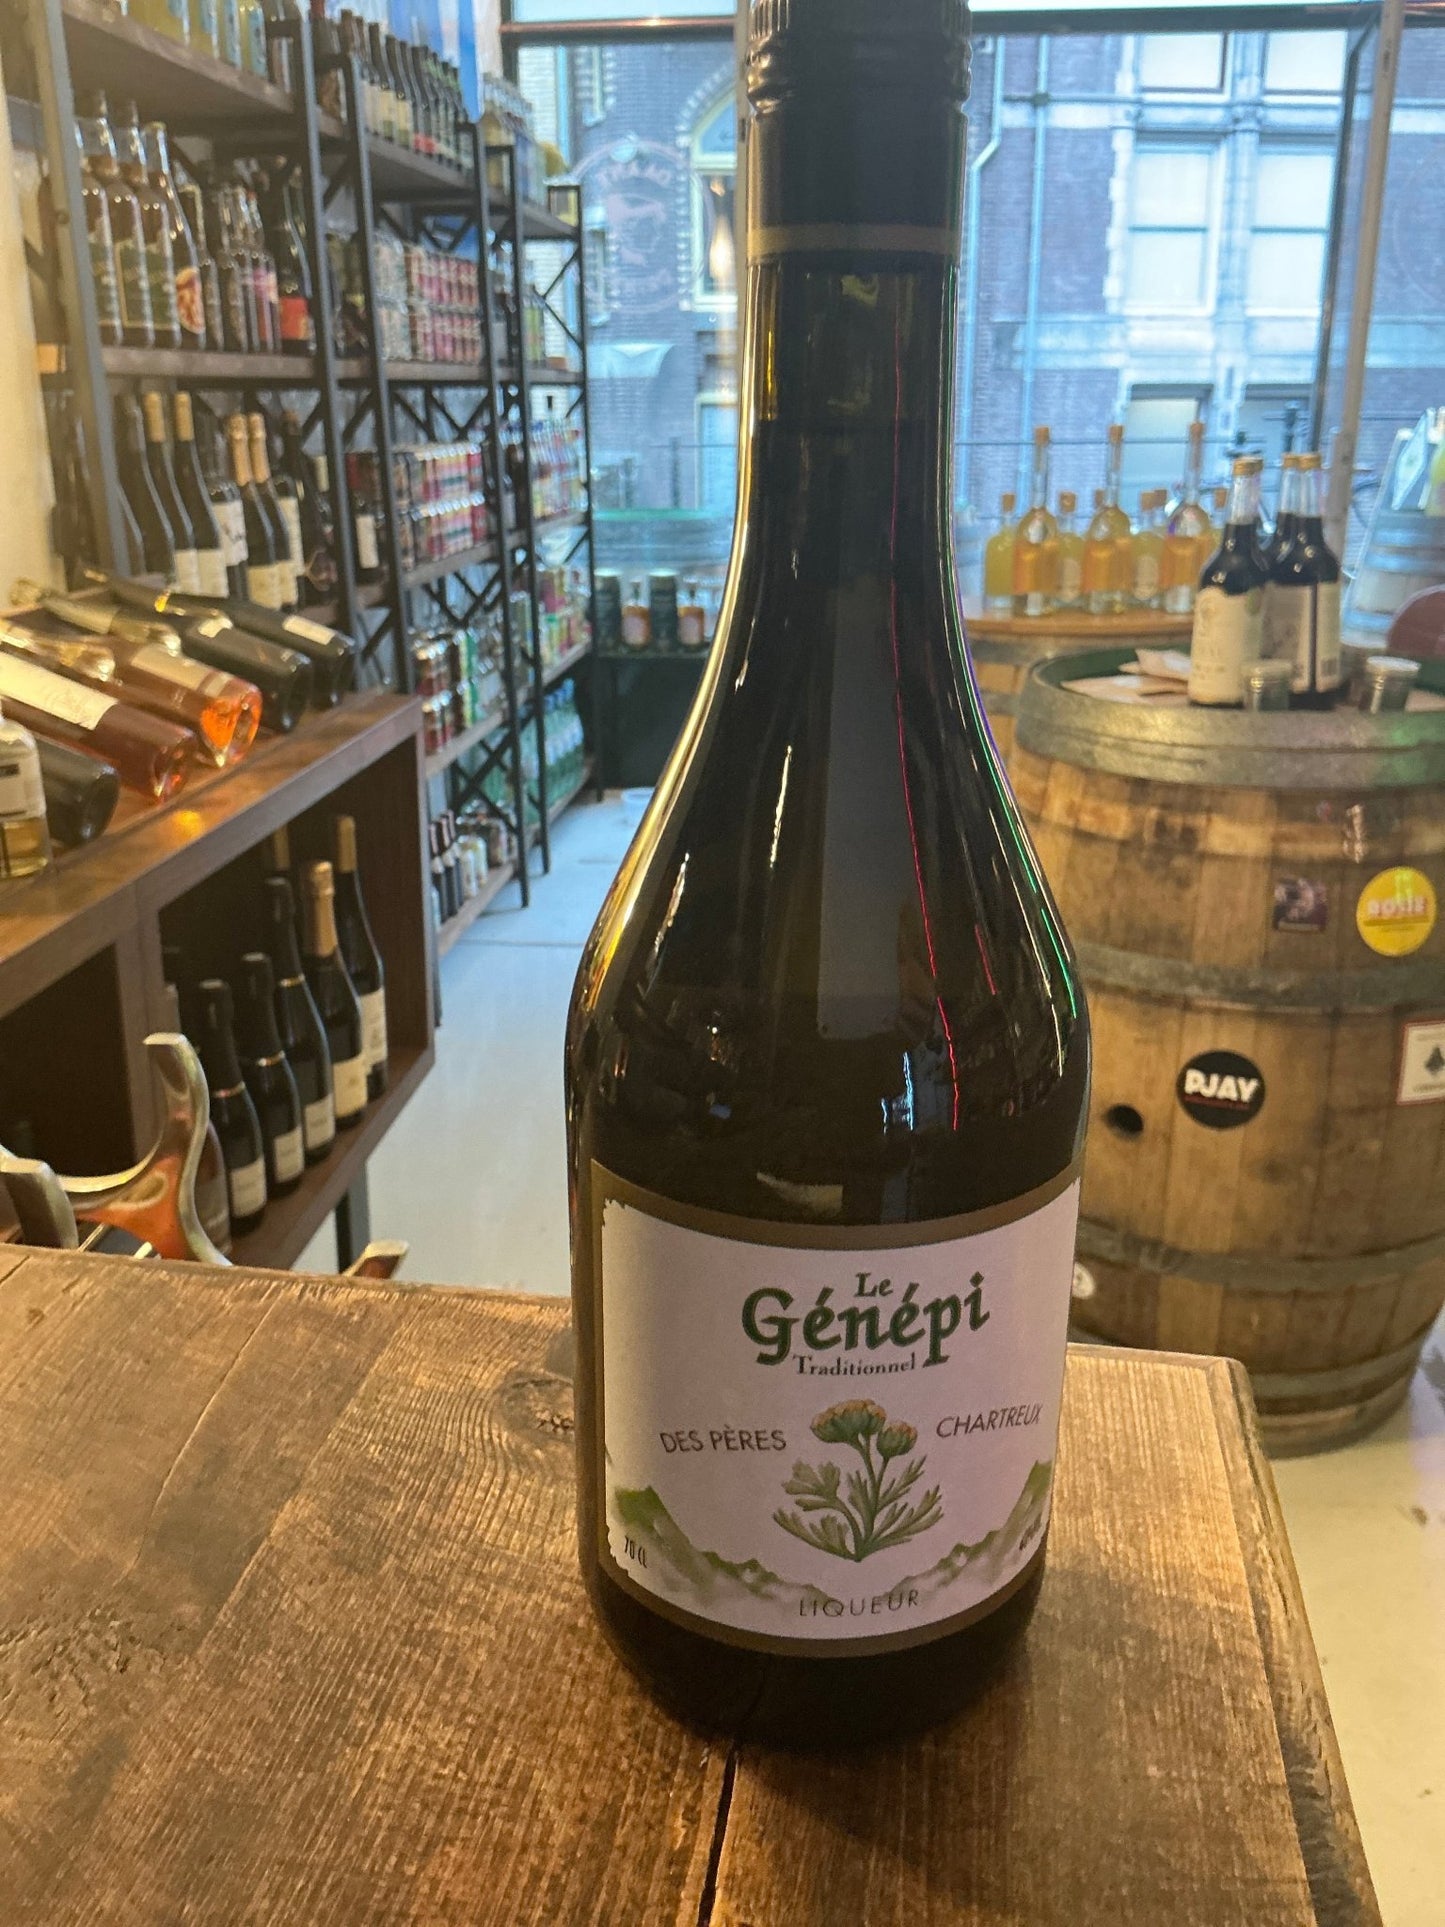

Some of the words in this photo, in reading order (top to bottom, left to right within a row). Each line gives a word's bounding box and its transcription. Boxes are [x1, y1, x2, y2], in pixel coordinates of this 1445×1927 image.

[854, 1272, 894, 1297] Le
[741, 1271, 990, 1368] Génépi
[792, 1352, 916, 1376] Traditionnel
[660, 1429, 704, 1453] DES
[709, 1424, 786, 1452] PÈRES
[936, 1403, 1043, 1438] CHARTREUX
[799, 1589, 919, 1617] LIQUEUR
